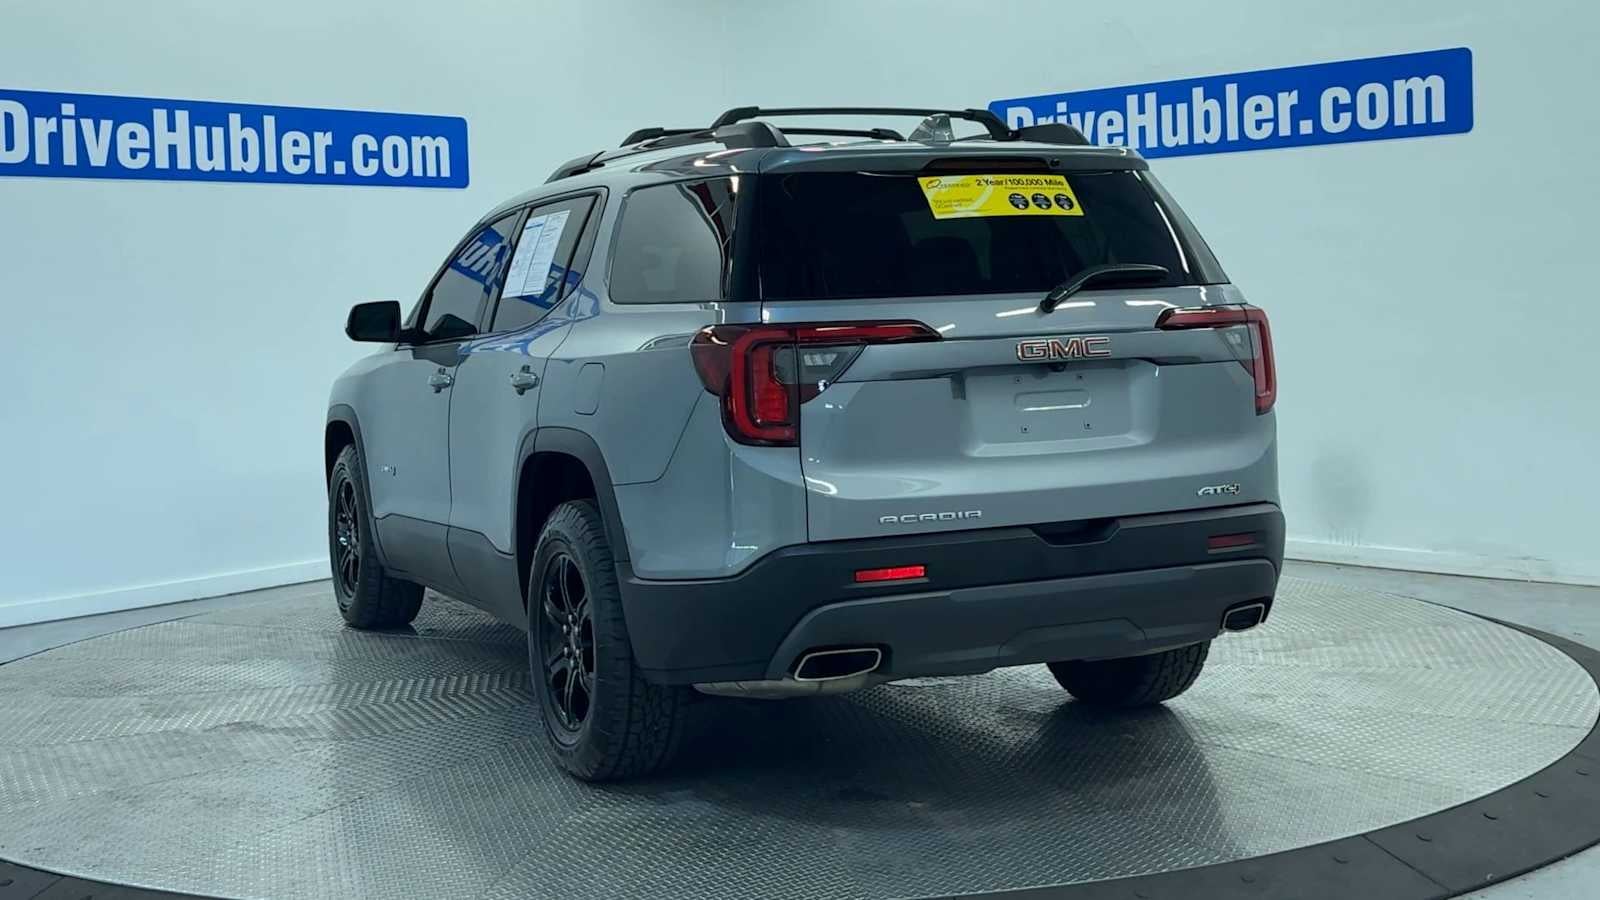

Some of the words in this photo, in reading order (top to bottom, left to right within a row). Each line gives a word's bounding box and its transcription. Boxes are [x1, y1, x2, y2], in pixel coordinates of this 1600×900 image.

[1007, 74, 1446, 150] veHubler.com
[0, 99, 451, 178] DriveHubler.com
[975, 178, 982, 187] 2
[1017, 336, 1112, 361] GMC
[1197, 483, 1241, 496] AT4
[879, 509, 982, 524] ACADIA
